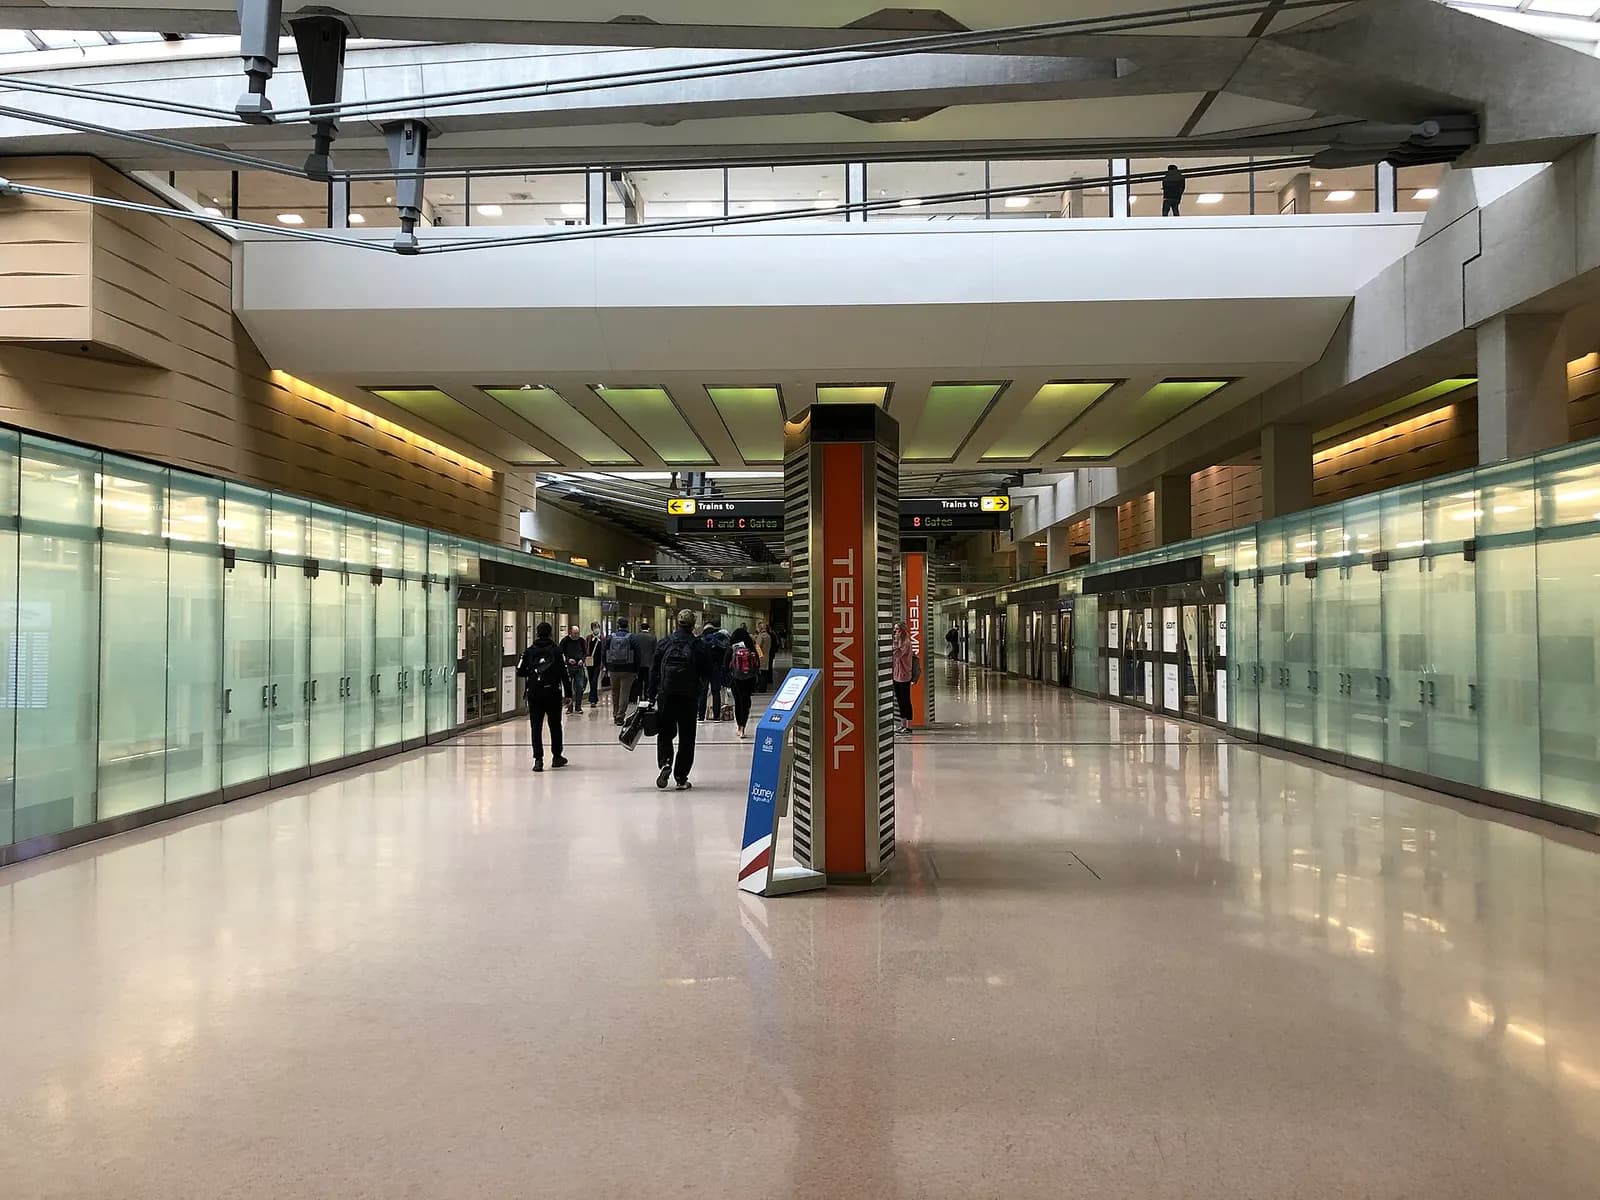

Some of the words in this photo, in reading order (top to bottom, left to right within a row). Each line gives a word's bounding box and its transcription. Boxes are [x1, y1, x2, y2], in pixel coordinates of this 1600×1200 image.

[698, 502, 723, 511] Trains
[725, 502, 735, 511] to
[941, 500, 967, 509] Trains
[969, 501, 979, 509] to
[706, 518, 714, 529] A
[718, 519, 735, 528] and
[738, 518, 746, 529] C
[750, 518, 777, 528] Gates
[924, 516, 953, 527] Gates
[832, 548, 856, 770] TERMINAL
